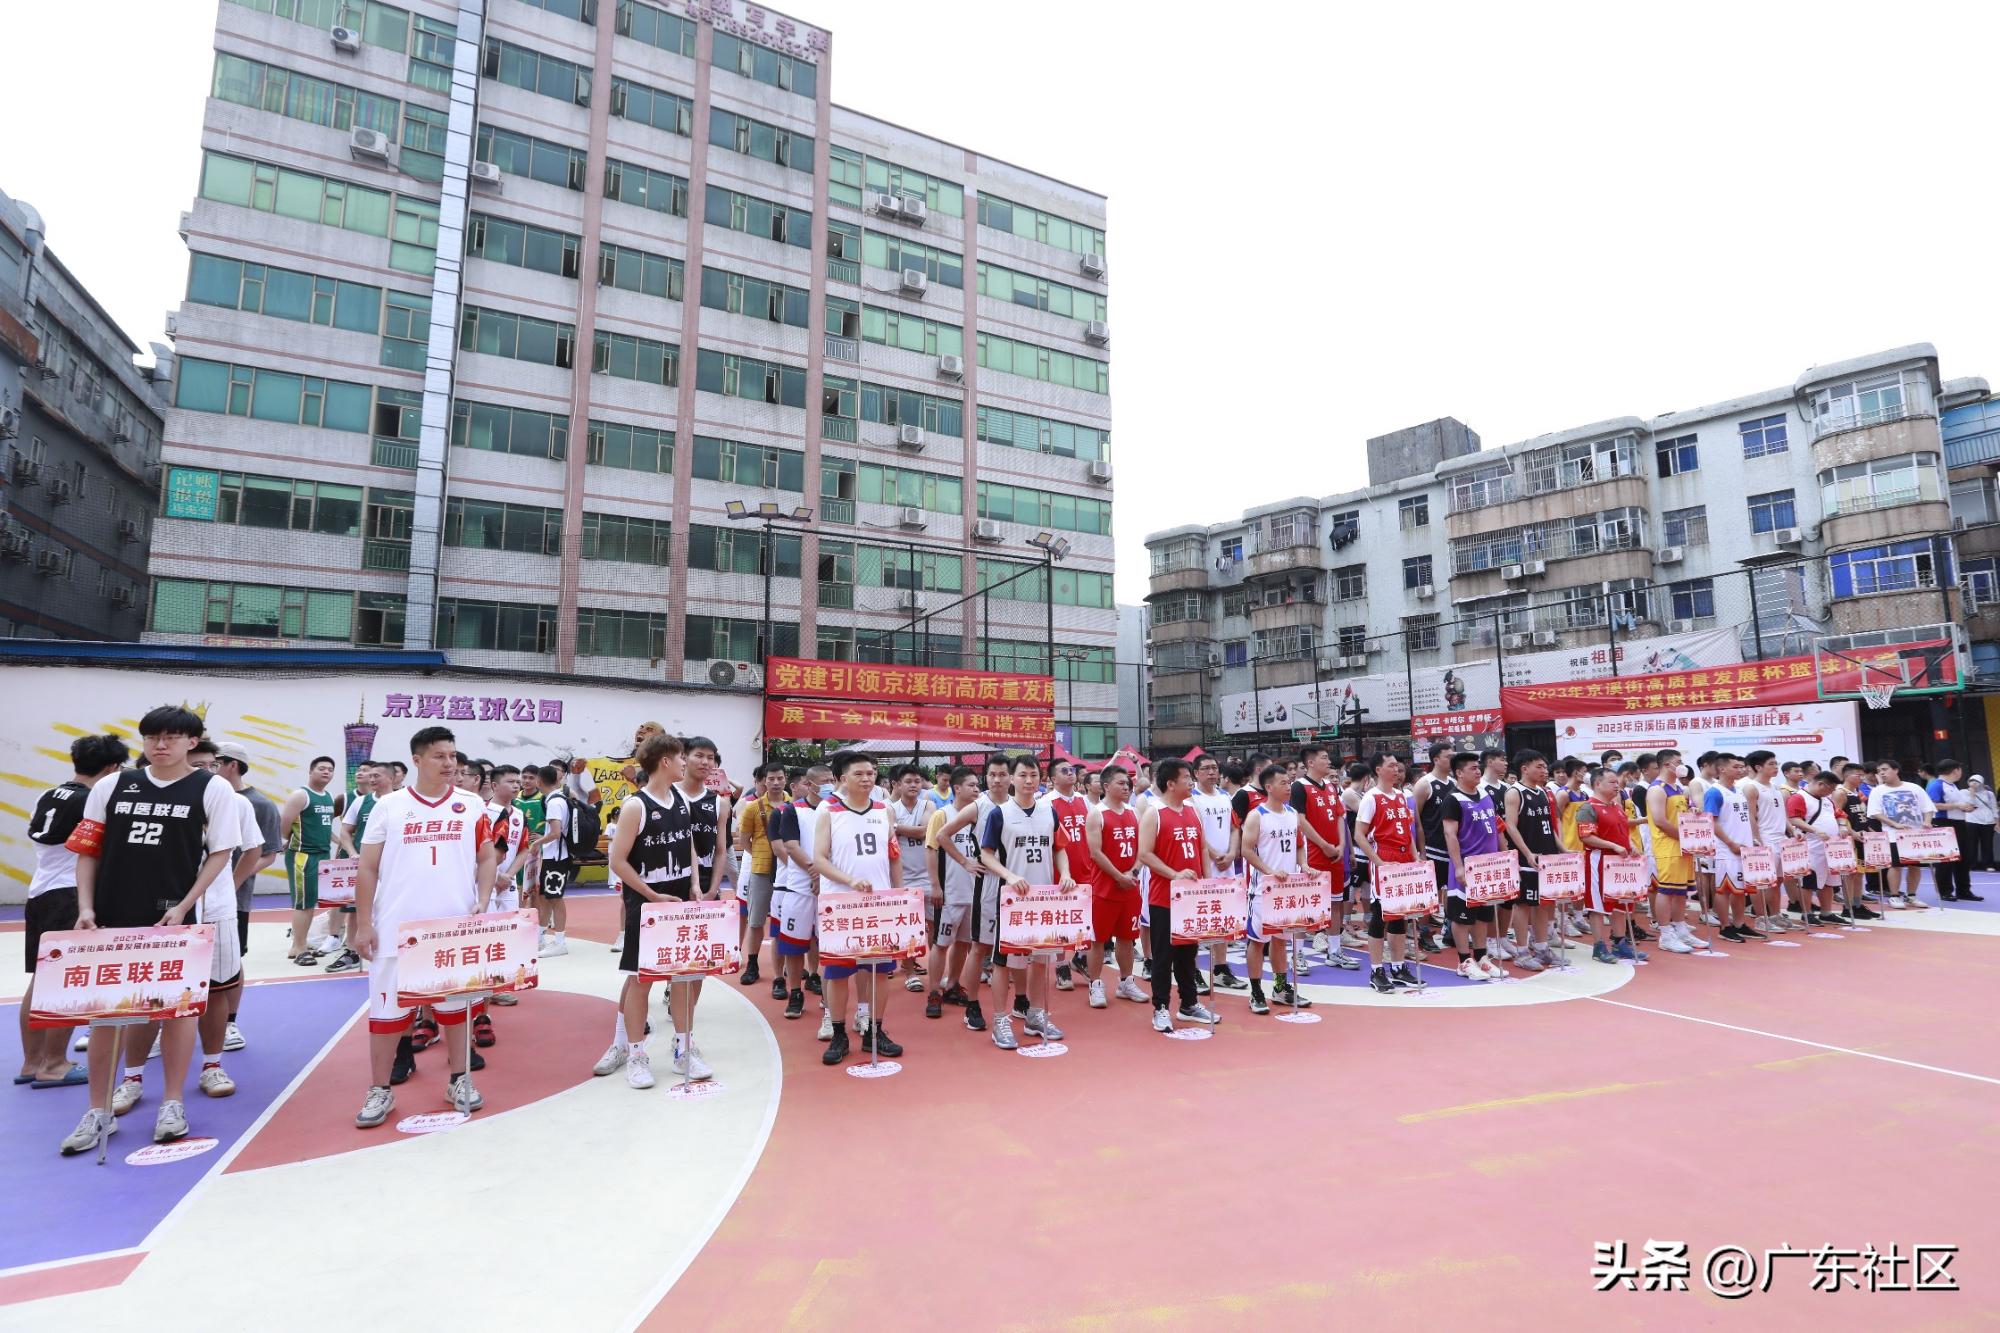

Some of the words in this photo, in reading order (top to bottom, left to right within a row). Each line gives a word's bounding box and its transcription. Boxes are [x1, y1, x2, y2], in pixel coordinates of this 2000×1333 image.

[1591, 646, 1623, 664] 祖国
[1625, 686, 1757, 710] 京溪联社赛区
[382, 693, 563, 725] 京溪篮球公园
[781, 706, 917, 727] 展工会风采
[1597, 712, 1791, 733] 2023年京溪街高质量发展杯篮球比赛
[114, 801, 190, 818] 南医联盟
[1326, 809, 1334, 820] 2
[403, 820, 463, 835] 新百佳
[1063, 815, 1086, 827] 云英
[1216, 816, 1222, 829] 7
[1396, 821, 1404, 835] 5
[127, 821, 164, 845] 22
[1070, 829, 1081, 841] 15
[1113, 827, 1136, 840] 云英
[1173, 827, 1198, 840] 云英
[855, 833, 877, 856] 19
[1015, 836, 1049, 848] 犀牛角
[1120, 842, 1133, 858] 26
[1181, 842, 1195, 859] 13
[1280, 839, 1291, 852] 12
[430, 846, 437, 865] 1
[1026, 849, 1042, 863] 23
[1473, 866, 1511, 884] 京溪街道
[1546, 870, 1579, 885] 南方医院
[1614, 872, 1637, 884] 烈火队
[1384, 880, 1434, 899] 京溪派出所
[1469, 883, 1517, 898] 机关工会队
[1526, 889, 1538, 900] 21
[1196, 900, 1222, 916] 云英
[1272, 893, 1322, 911] 京溪小学
[787, 918, 795, 931] 6
[822, 913, 922, 933] 交警白云一大队
[1009, 909, 1084, 927] 犀牛角社区
[1183, 916, 1236, 934] 实验学校
[676, 924, 709, 944] 京溪
[434, 942, 507, 969] 新百佳
[656, 944, 725, 966] 篮球公园
[63, 960, 185, 989] 南医联盟
